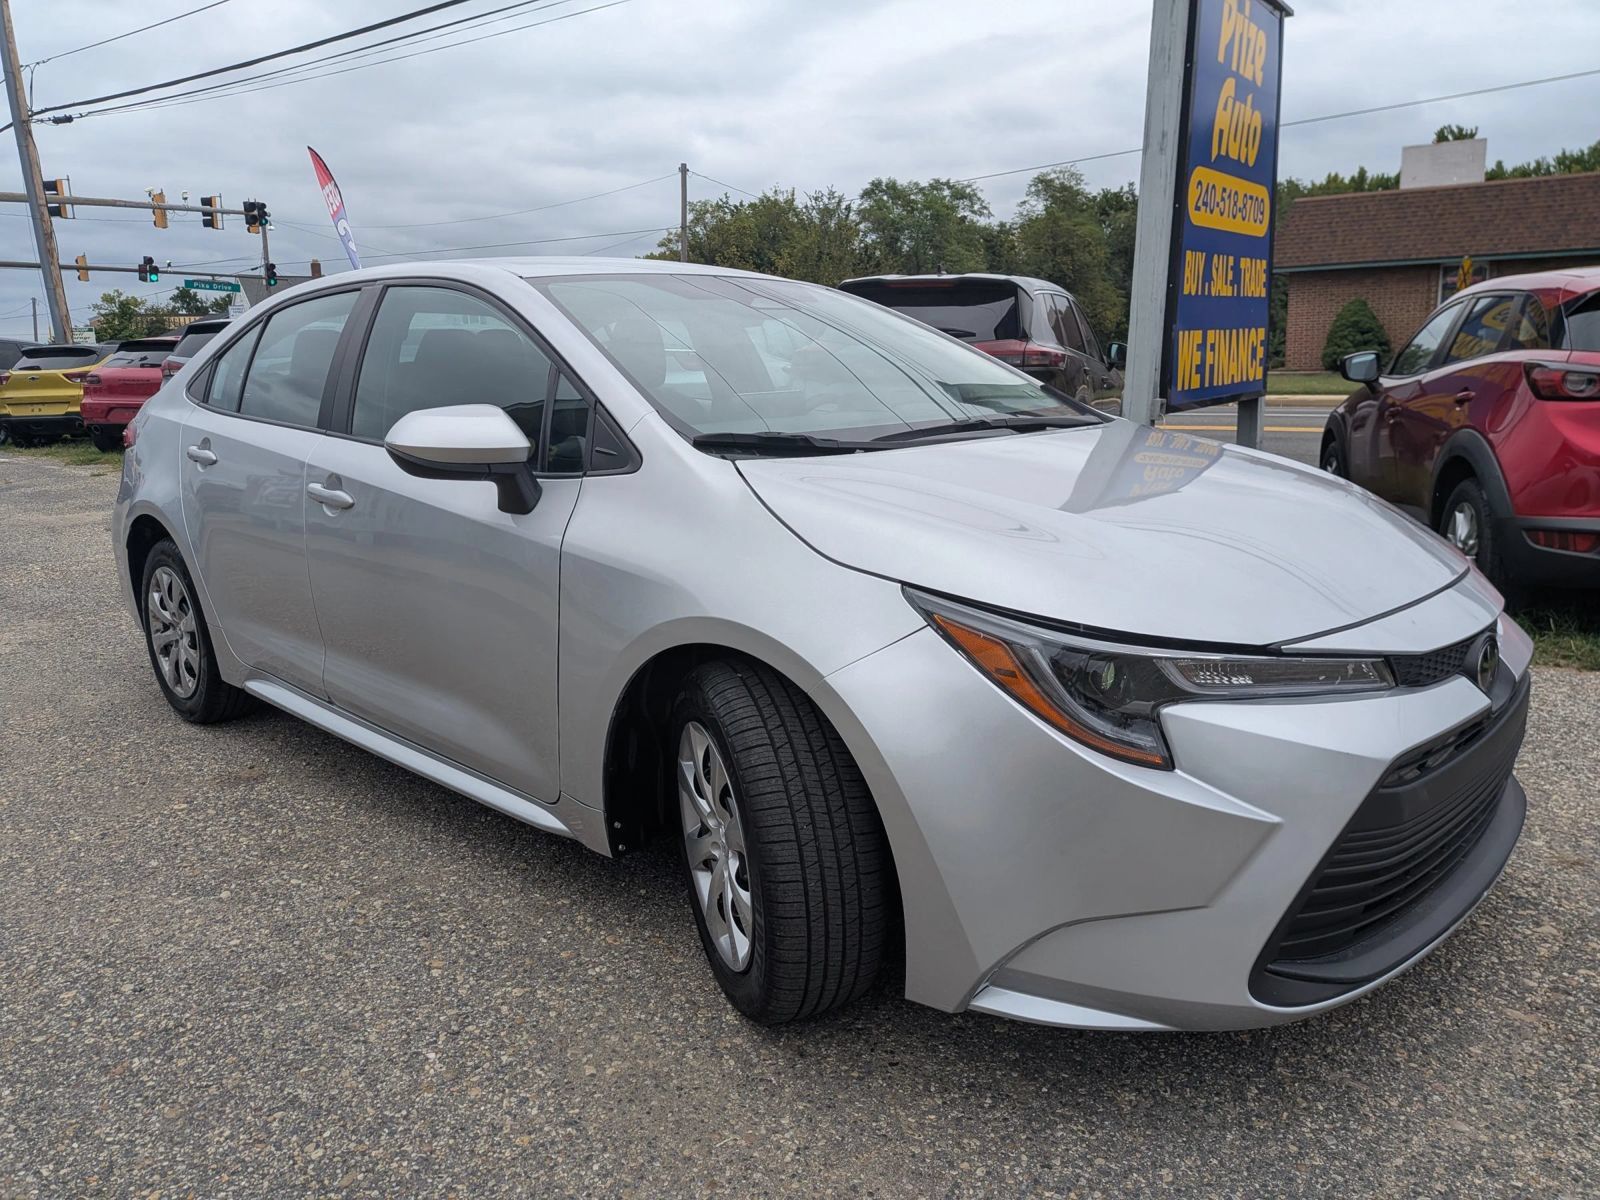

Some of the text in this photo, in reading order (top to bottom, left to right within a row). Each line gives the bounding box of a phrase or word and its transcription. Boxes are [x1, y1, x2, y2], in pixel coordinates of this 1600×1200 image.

[1217, 0, 1267, 87] Prize
[1211, 77, 1262, 168] Auto
[1193, 178, 1265, 226] 240-518-8709
[193, 281, 210, 289] Pike
[1183, 250, 1206, 296] BUY
[1210, 253, 1234, 297] SALE
[1240, 256, 1267, 298] TRADE
[1177, 327, 1265, 391] WE FINANCE
